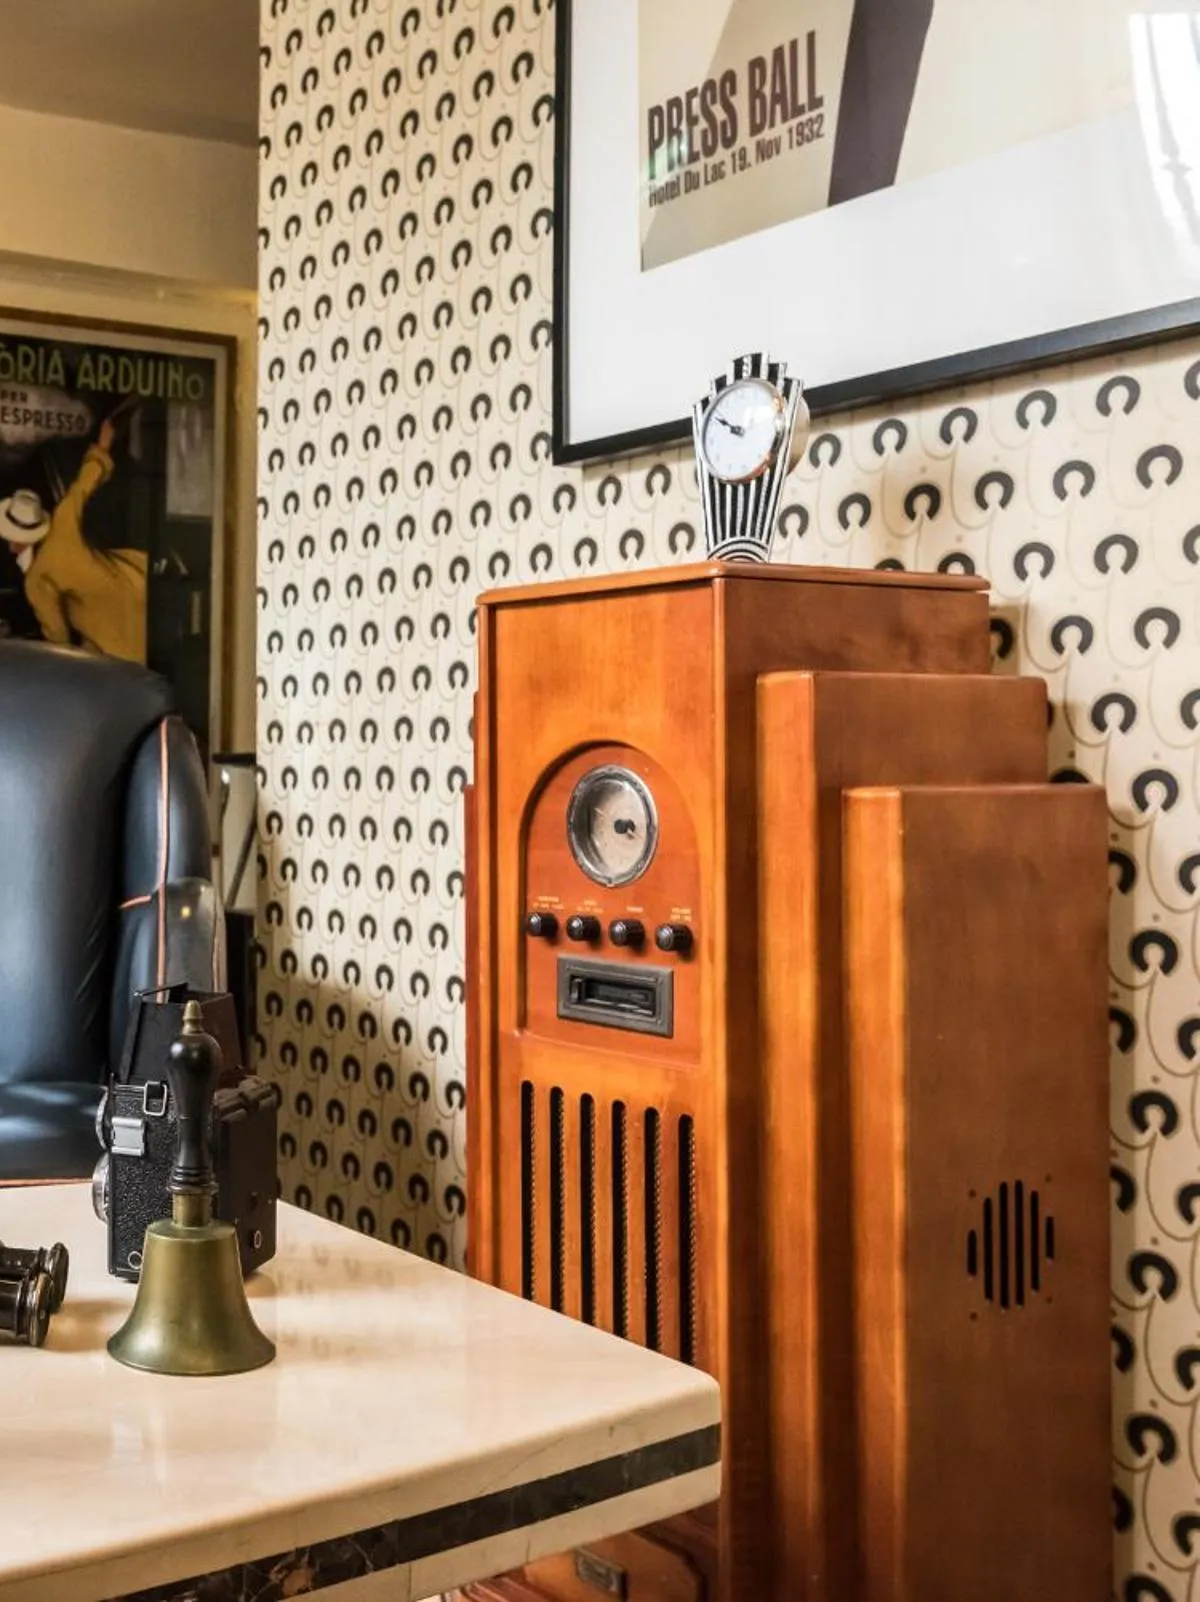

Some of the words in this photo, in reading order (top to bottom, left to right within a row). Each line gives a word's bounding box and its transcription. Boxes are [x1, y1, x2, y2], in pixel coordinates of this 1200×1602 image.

[647, 68, 738, 181] PRESS
[747, 29, 824, 138] BALL
[649, 175, 681, 207] Hotel
[684, 169, 700, 194] Du
[704, 160, 726, 186] Lac
[731, 146, 752, 174] 19.
[756, 136, 782, 164] Nov
[787, 113, 825, 150] 1932
[76, 352, 205, 400] ARDUINO
[0, 405, 86, 432] ESPRESSO
